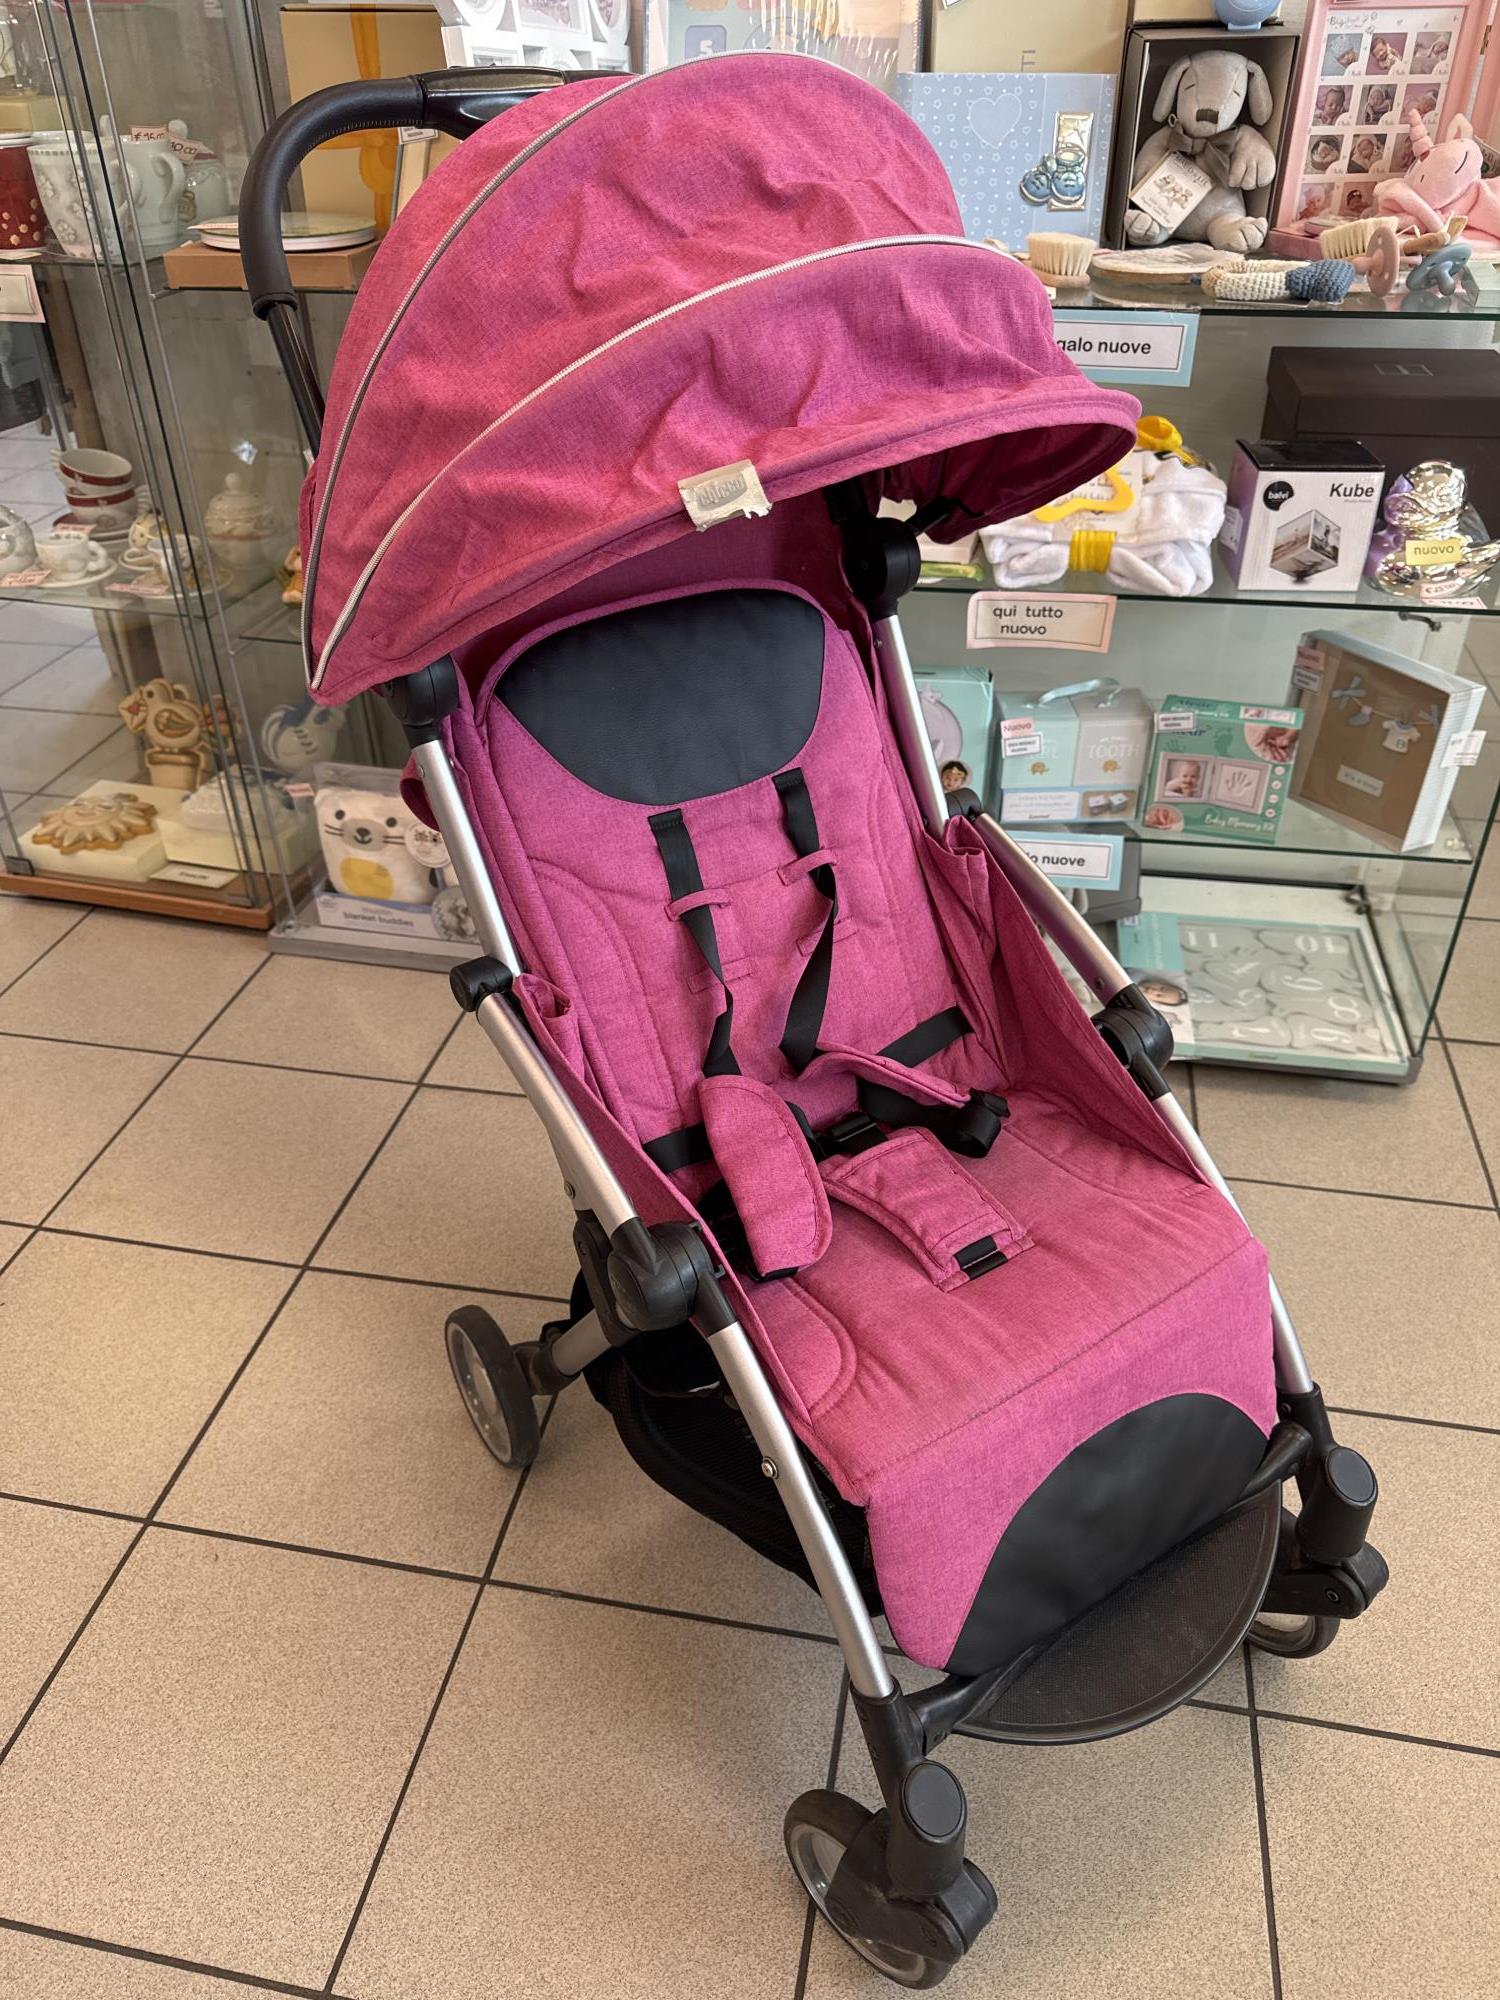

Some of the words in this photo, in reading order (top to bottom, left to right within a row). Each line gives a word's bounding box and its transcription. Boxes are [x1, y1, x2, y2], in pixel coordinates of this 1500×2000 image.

[1098, 341, 1151, 355] nuove
[1329, 483, 1375, 498] Kube
[1413, 545, 1455, 556] nuovo
[992, 605, 1017, 619] qui
[1025, 606, 1063, 619] tutto
[1000, 624, 1047, 635] nuovo
[1042, 855, 1086, 867] nuove
